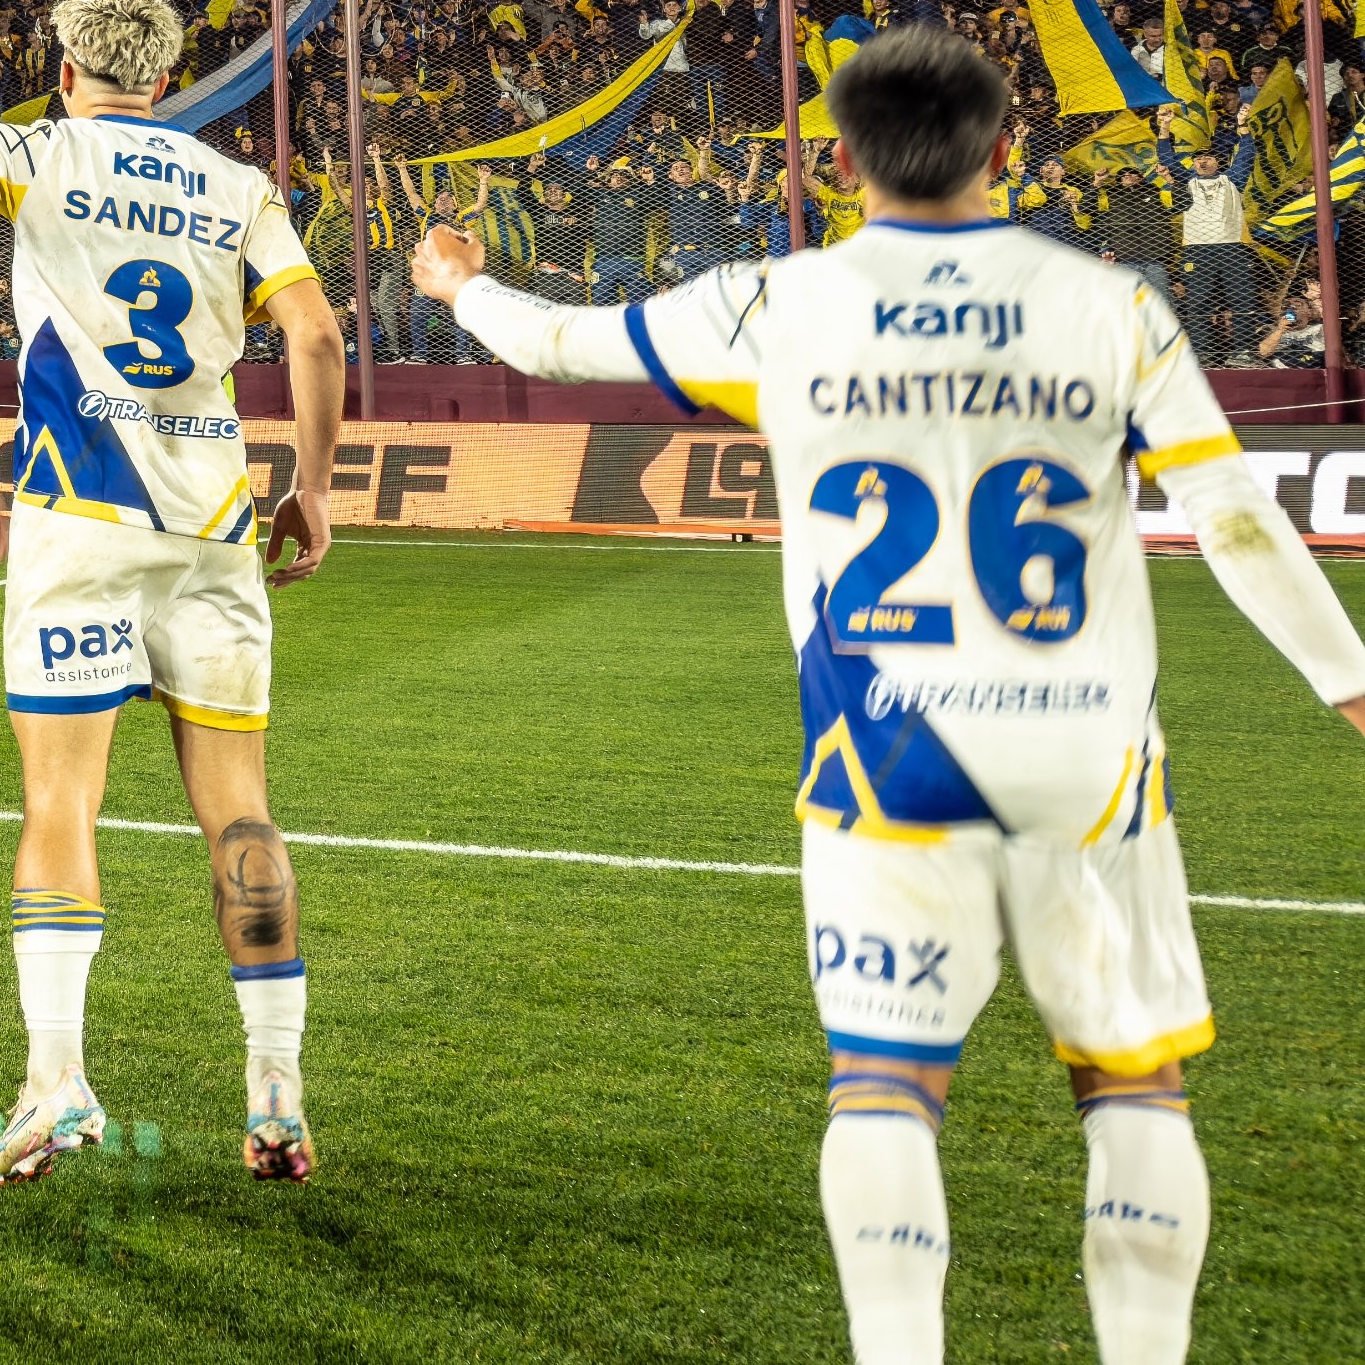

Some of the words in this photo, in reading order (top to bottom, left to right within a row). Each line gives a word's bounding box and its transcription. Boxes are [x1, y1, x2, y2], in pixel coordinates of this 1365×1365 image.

[64, 190, 242, 252] SANDEZ
[103, 259, 196, 390] 3
[143, 364, 175, 376] RUS
[808, 371, 1096, 421] CANTIZANO
[808, 452, 1096, 655] 26
[39, 619, 133, 669] pax
[45, 662, 132, 682] assistance
